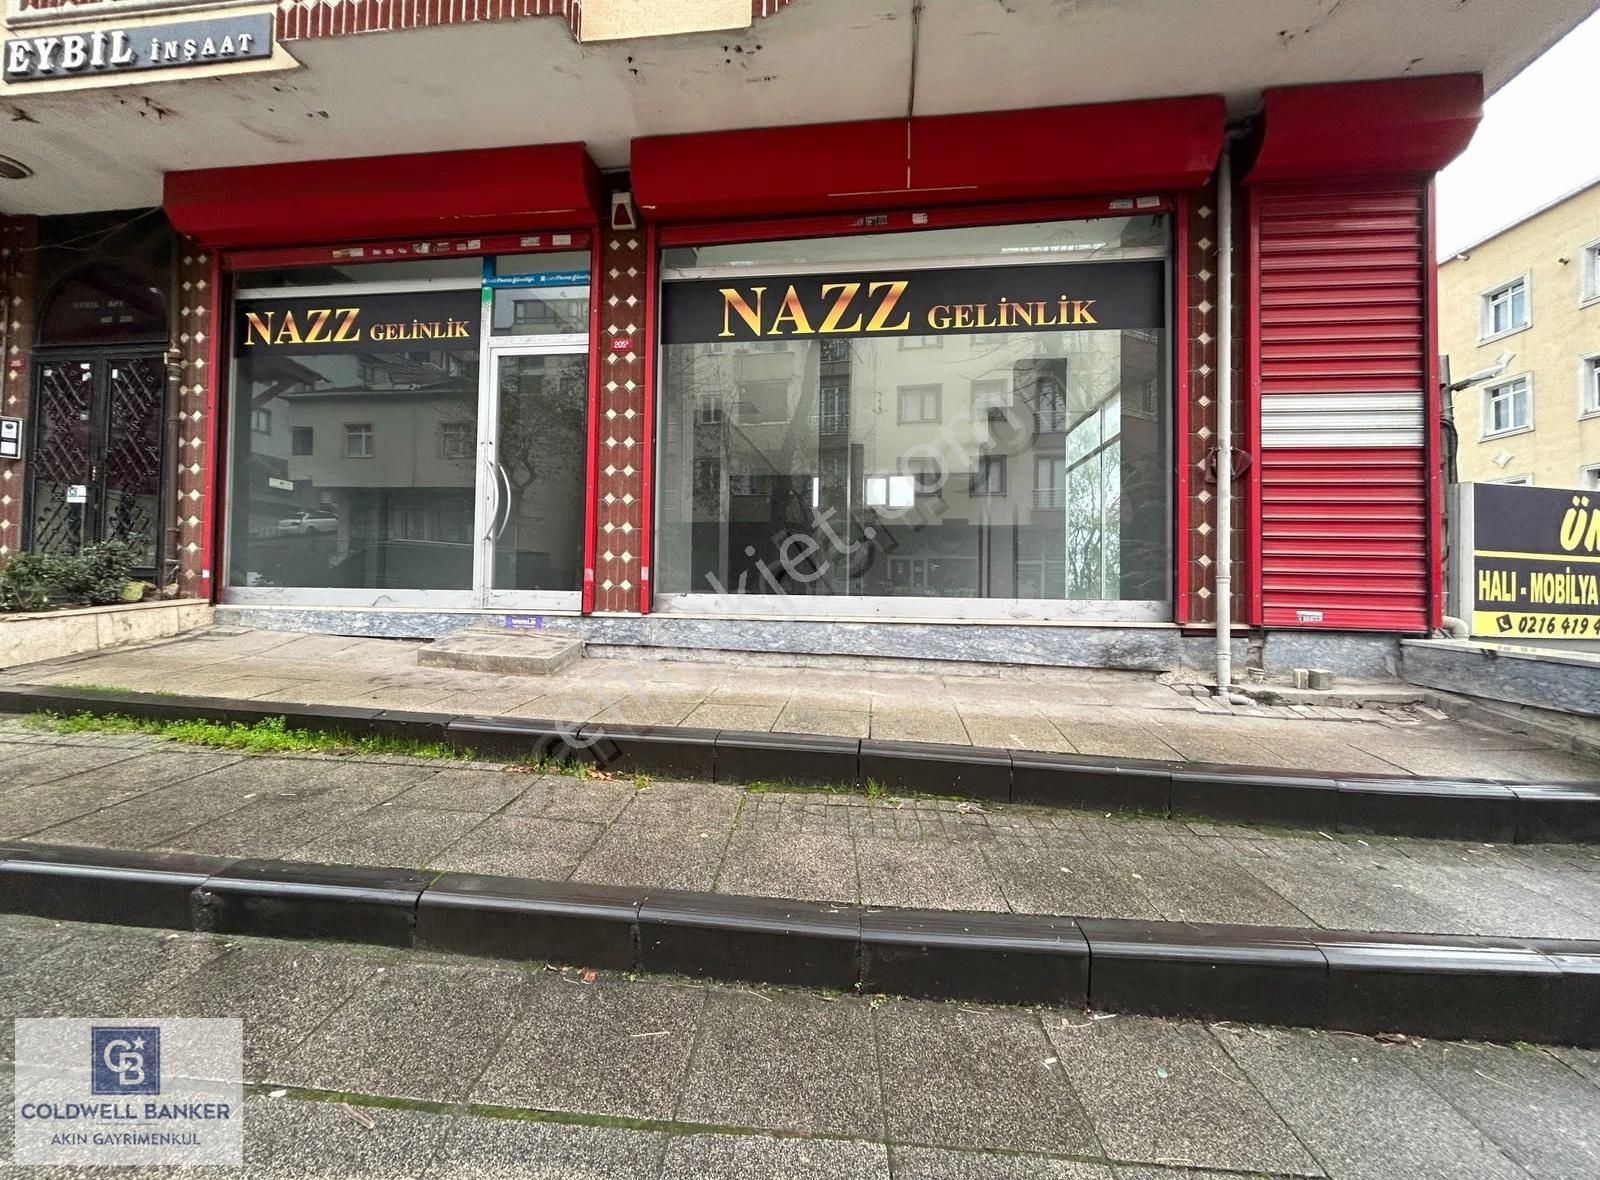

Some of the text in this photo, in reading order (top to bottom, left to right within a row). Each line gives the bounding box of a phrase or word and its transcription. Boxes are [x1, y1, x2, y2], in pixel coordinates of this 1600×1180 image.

[244, 307, 470, 345] NAZZ GELİNLİK
[718, 280, 1097, 337] NAZZ GELİNLİK
[1478, 569, 1517, 602] HALI
[1530, 566, 1599, 605] MOBİLYA
[1518, 616, 1556, 634] 0216
[1561, 616, 1589, 635] 419
